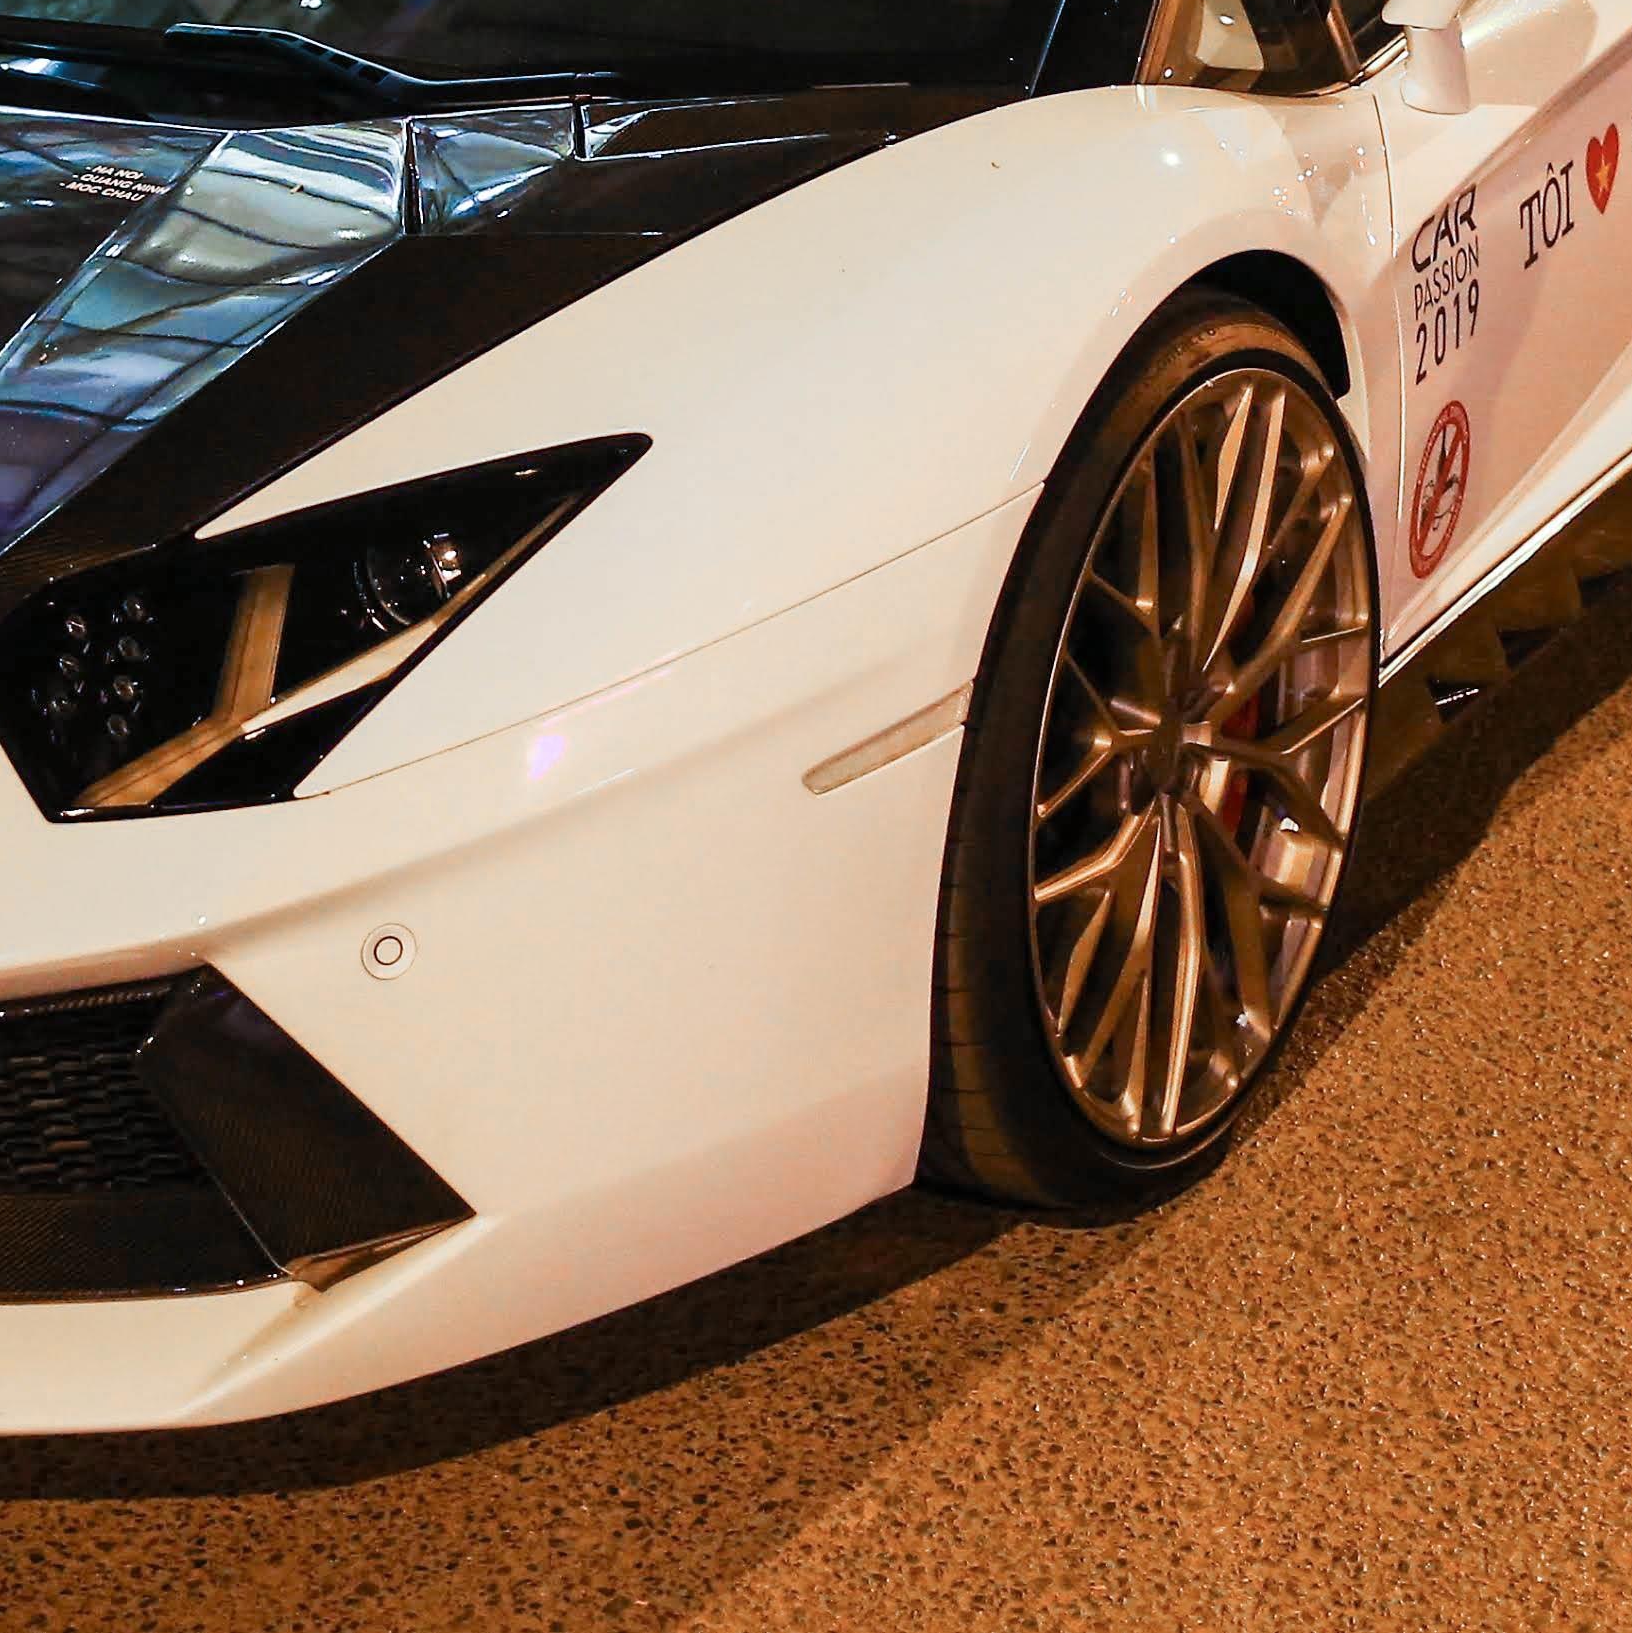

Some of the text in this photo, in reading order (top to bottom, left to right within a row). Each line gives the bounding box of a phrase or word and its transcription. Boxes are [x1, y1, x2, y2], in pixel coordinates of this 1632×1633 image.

[66, 181, 146, 201] MOC CHAU
[80, 173, 171, 195] QUANG NINH
[114, 168, 144, 180] NOI
[1519, 161, 1575, 269] TÔI
[1412, 183, 1477, 273] CAR
[1415, 235, 1479, 321] PASSION
[1416, 278, 1479, 386] 2019
